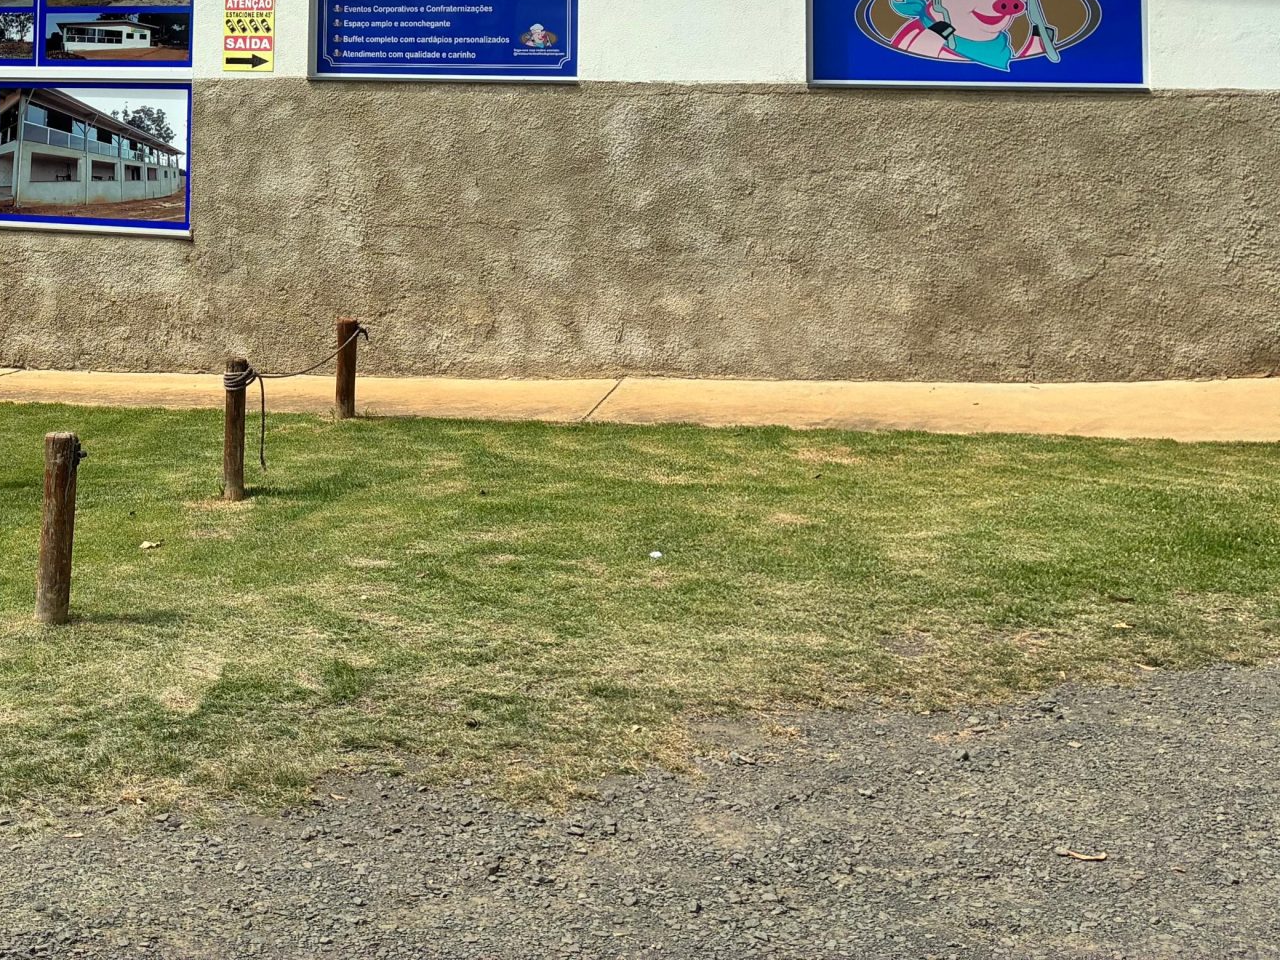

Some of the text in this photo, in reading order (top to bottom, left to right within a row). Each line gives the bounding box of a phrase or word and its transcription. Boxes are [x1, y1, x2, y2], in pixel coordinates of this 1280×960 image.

[343, 5, 372, 13] Eventos
[372, 5, 419, 14] Corporativos
[426, 4, 493, 14] Confraternizações
[343, 19, 370, 29] Espaço
[371, 20, 393, 29] amplo
[399, 20, 451, 29] aconchegante
[226, 36, 270, 49] SAÍDA
[343, 35, 365, 43] Buffet
[365, 35, 400, 44] completo
[416, 35, 453, 44] cardápios
[454, 35, 510, 44] personalizados
[342, 50, 387, 58] Atendimento
[404, 50, 441, 59] qualidade
[448, 50, 477, 59] carinho
